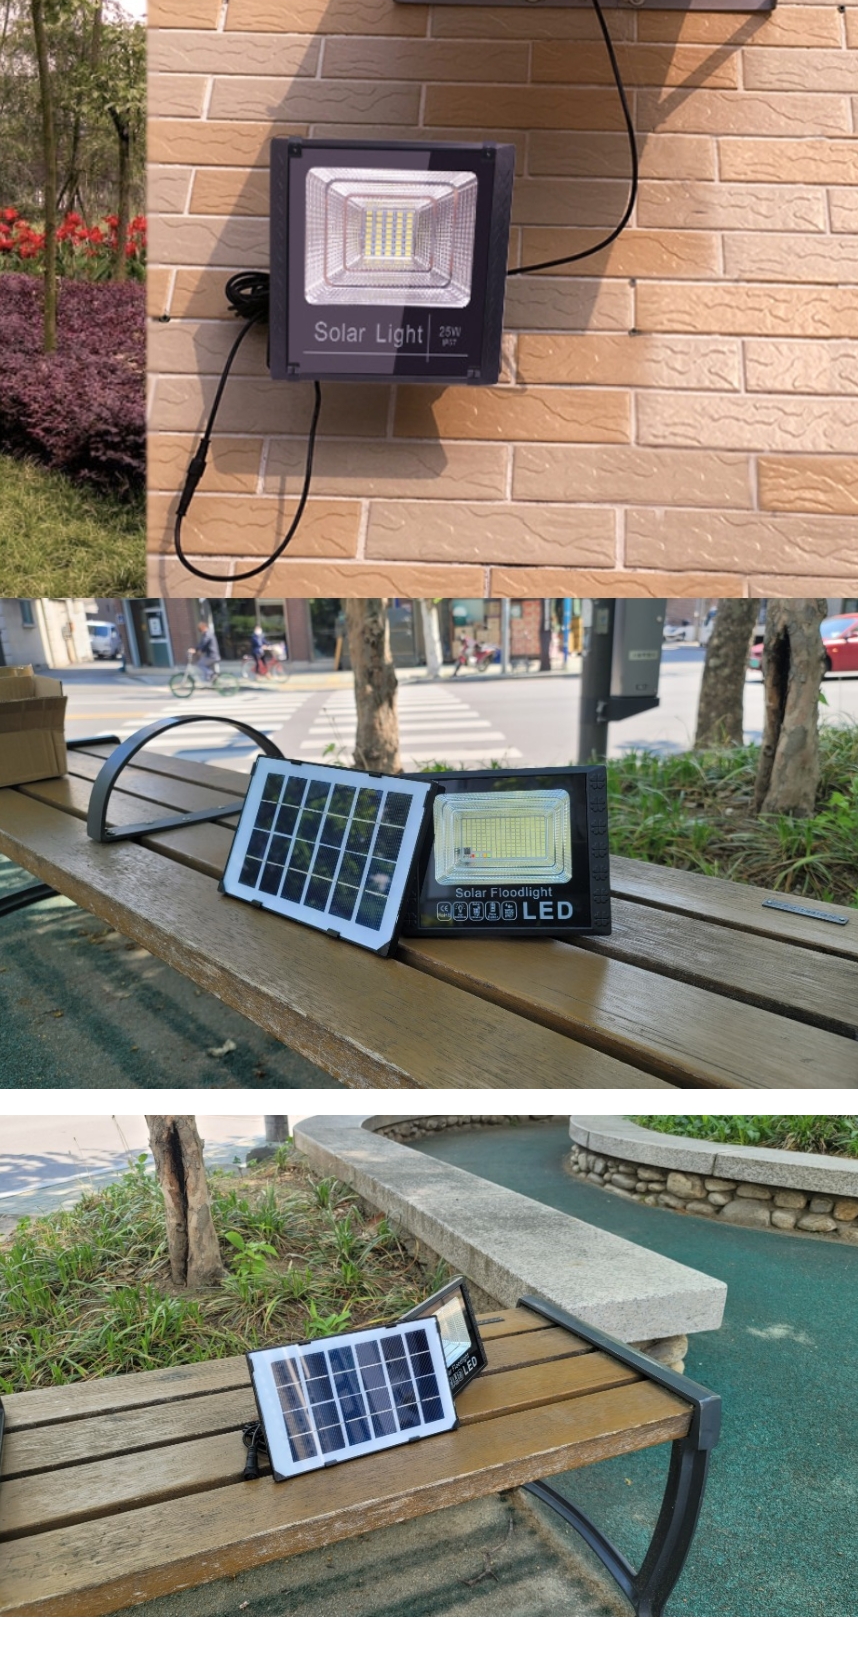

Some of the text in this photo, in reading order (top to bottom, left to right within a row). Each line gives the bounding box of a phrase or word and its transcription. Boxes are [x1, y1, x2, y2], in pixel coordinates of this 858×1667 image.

[314, 321, 424, 348] Solar Light
[439, 326, 461, 338] 25W
[455, 887, 553, 899] Solar Floodlight
[522, 901, 573, 920] LED
[462, 1356, 478, 1376] LED
